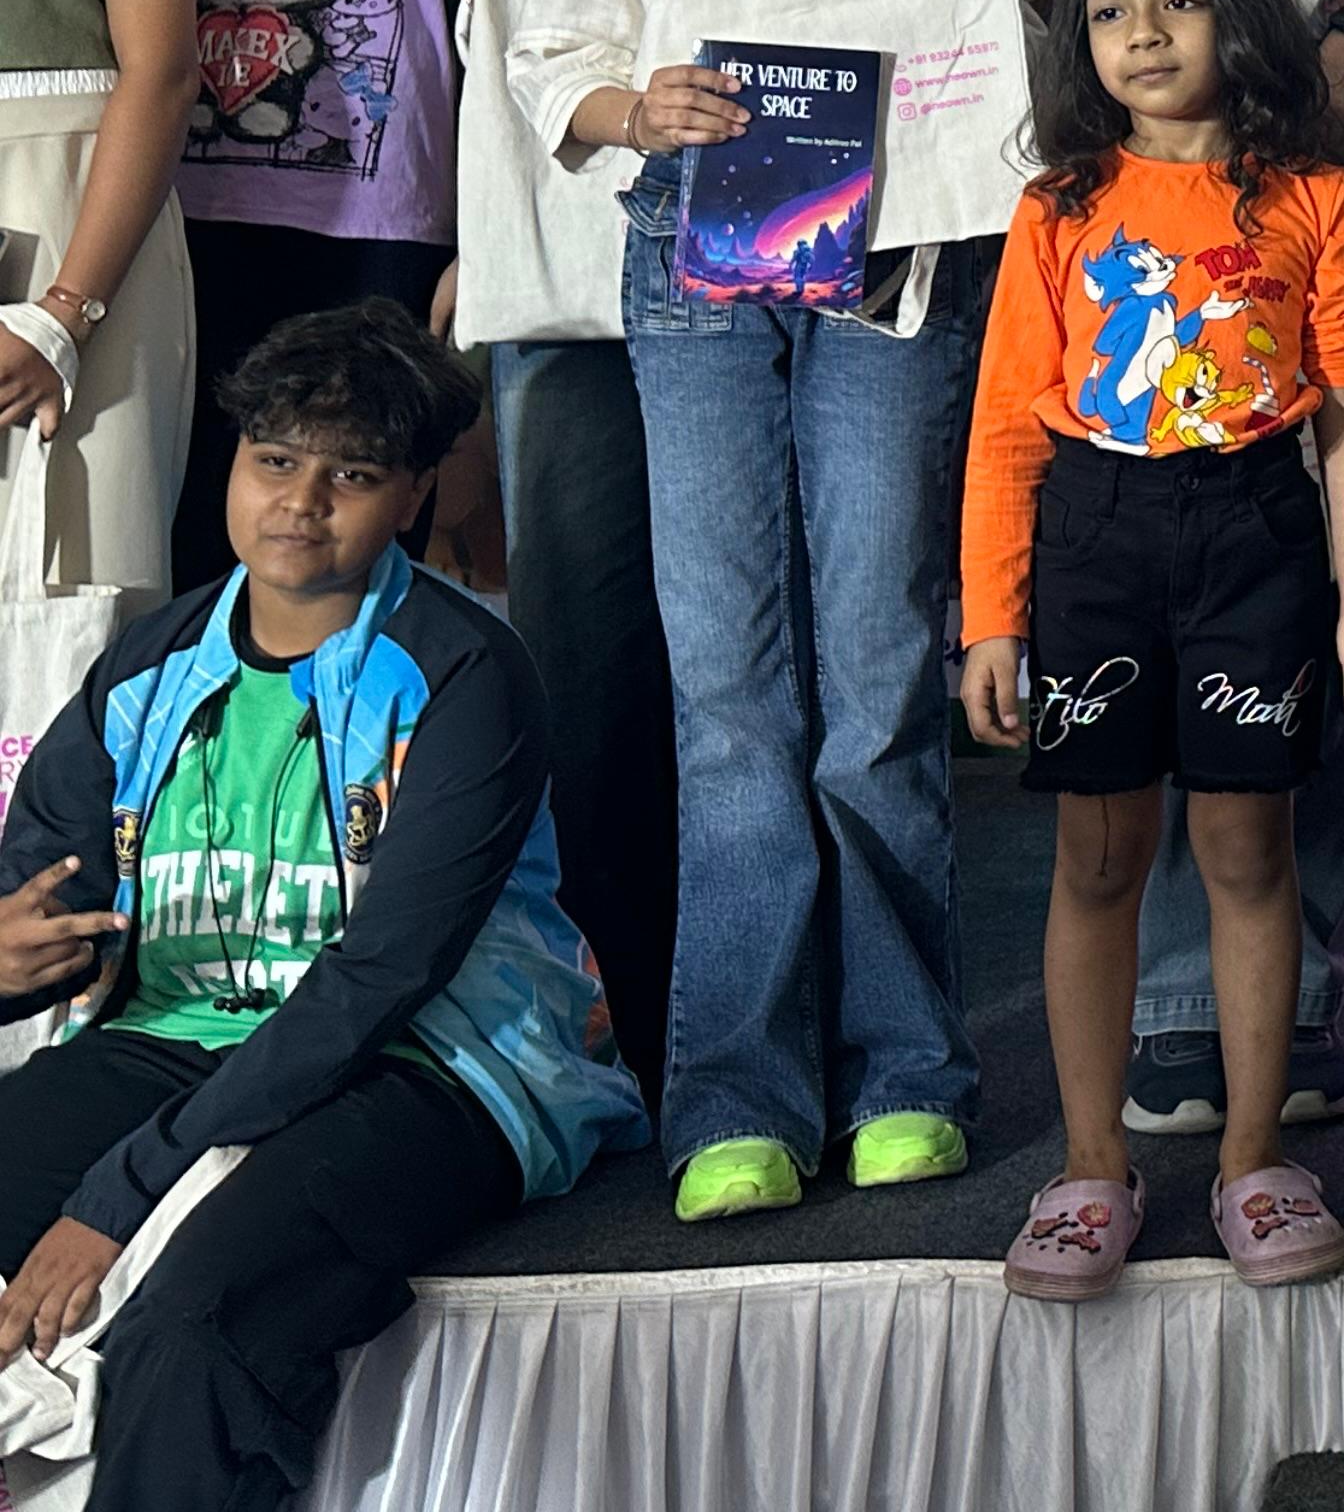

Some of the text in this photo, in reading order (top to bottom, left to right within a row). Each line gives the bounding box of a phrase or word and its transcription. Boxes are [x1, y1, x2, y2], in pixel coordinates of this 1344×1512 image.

[758, 63, 832, 92] VENTURE
[835, 70, 858, 93] TO
[760, 94, 813, 120] SPACE
[1194, 239, 1263, 282] TOM
